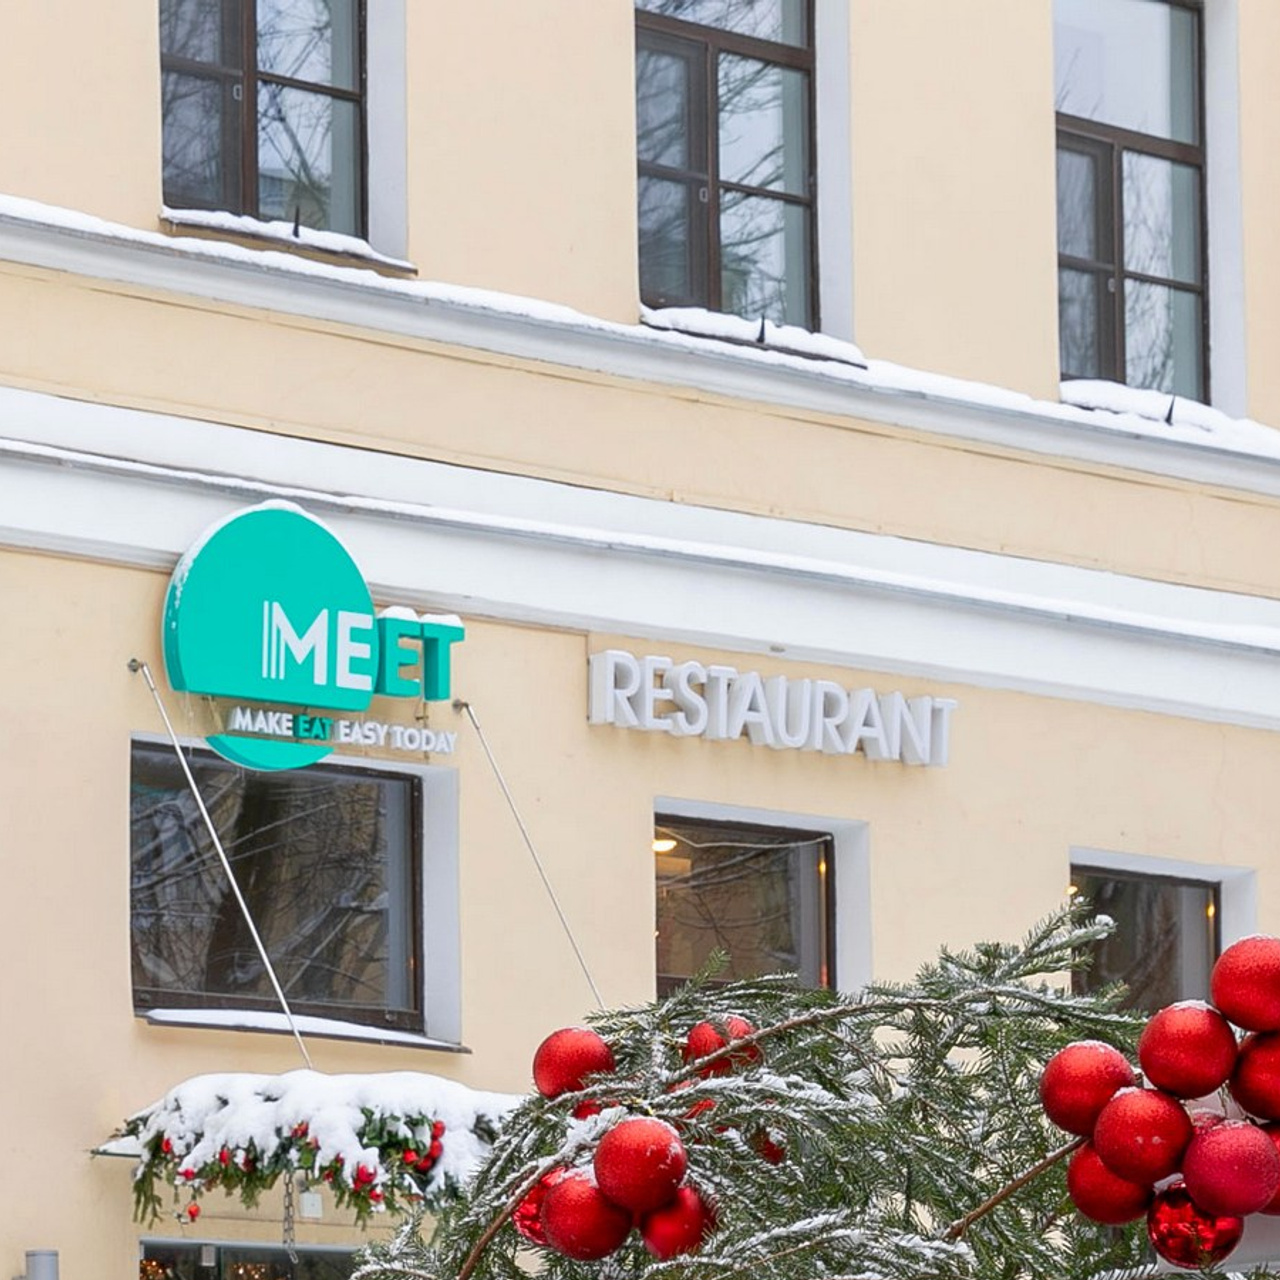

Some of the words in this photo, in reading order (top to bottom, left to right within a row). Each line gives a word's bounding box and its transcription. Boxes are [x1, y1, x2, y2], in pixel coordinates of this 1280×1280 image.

[261, 600, 465, 701] MEET
[230, 706, 293, 736] MAKE
[294, 713, 334, 740] EAT
[335, 720, 388, 746] EASY
[390, 726, 457, 753] TODAY
[589, 650, 958, 767] RESTAURANT
